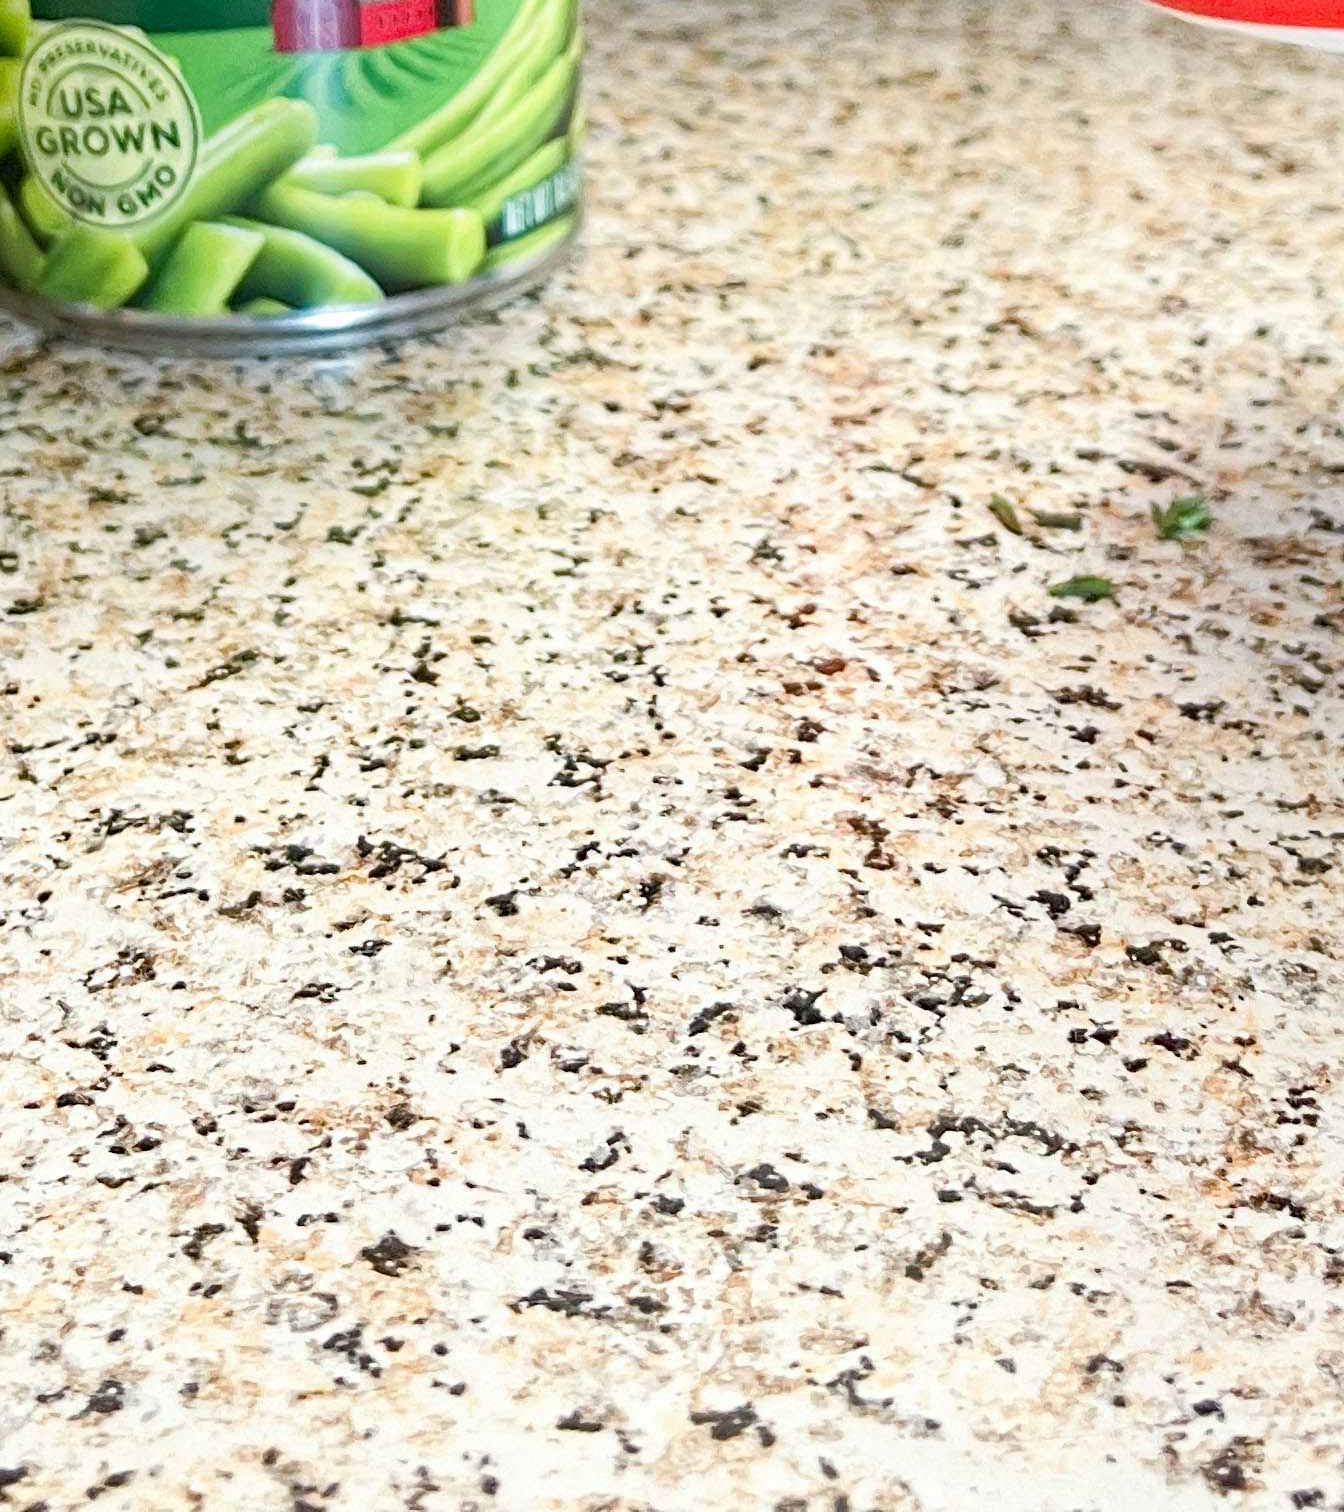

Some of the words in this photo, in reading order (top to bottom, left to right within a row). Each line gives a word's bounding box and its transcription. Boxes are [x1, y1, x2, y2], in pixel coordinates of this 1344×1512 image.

[60, 88, 132, 118] USA
[36, 120, 181, 155] GROWN
[52, 169, 105, 216] NON
[117, 165, 176, 216] GMO
